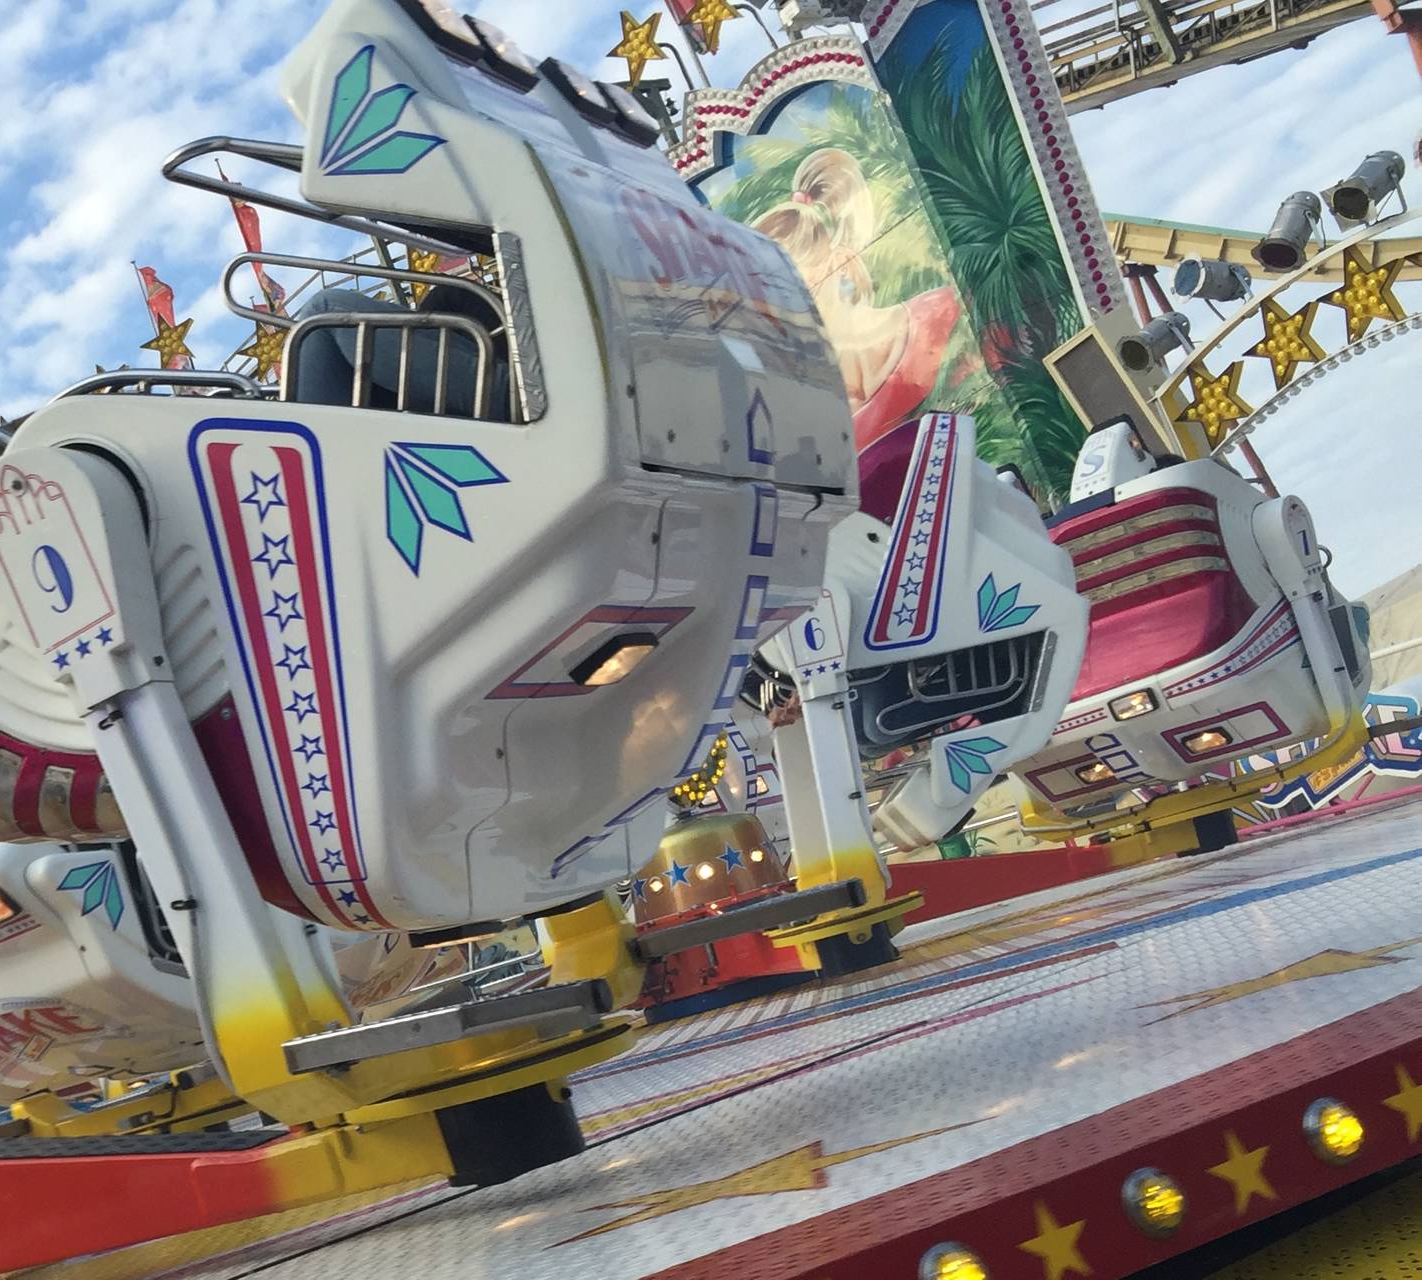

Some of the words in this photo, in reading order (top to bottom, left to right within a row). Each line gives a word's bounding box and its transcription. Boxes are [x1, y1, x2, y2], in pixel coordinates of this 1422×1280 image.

[1079, 444, 1107, 478] S
[31, 544, 74, 614] 9
[804, 617, 826, 651] 6
